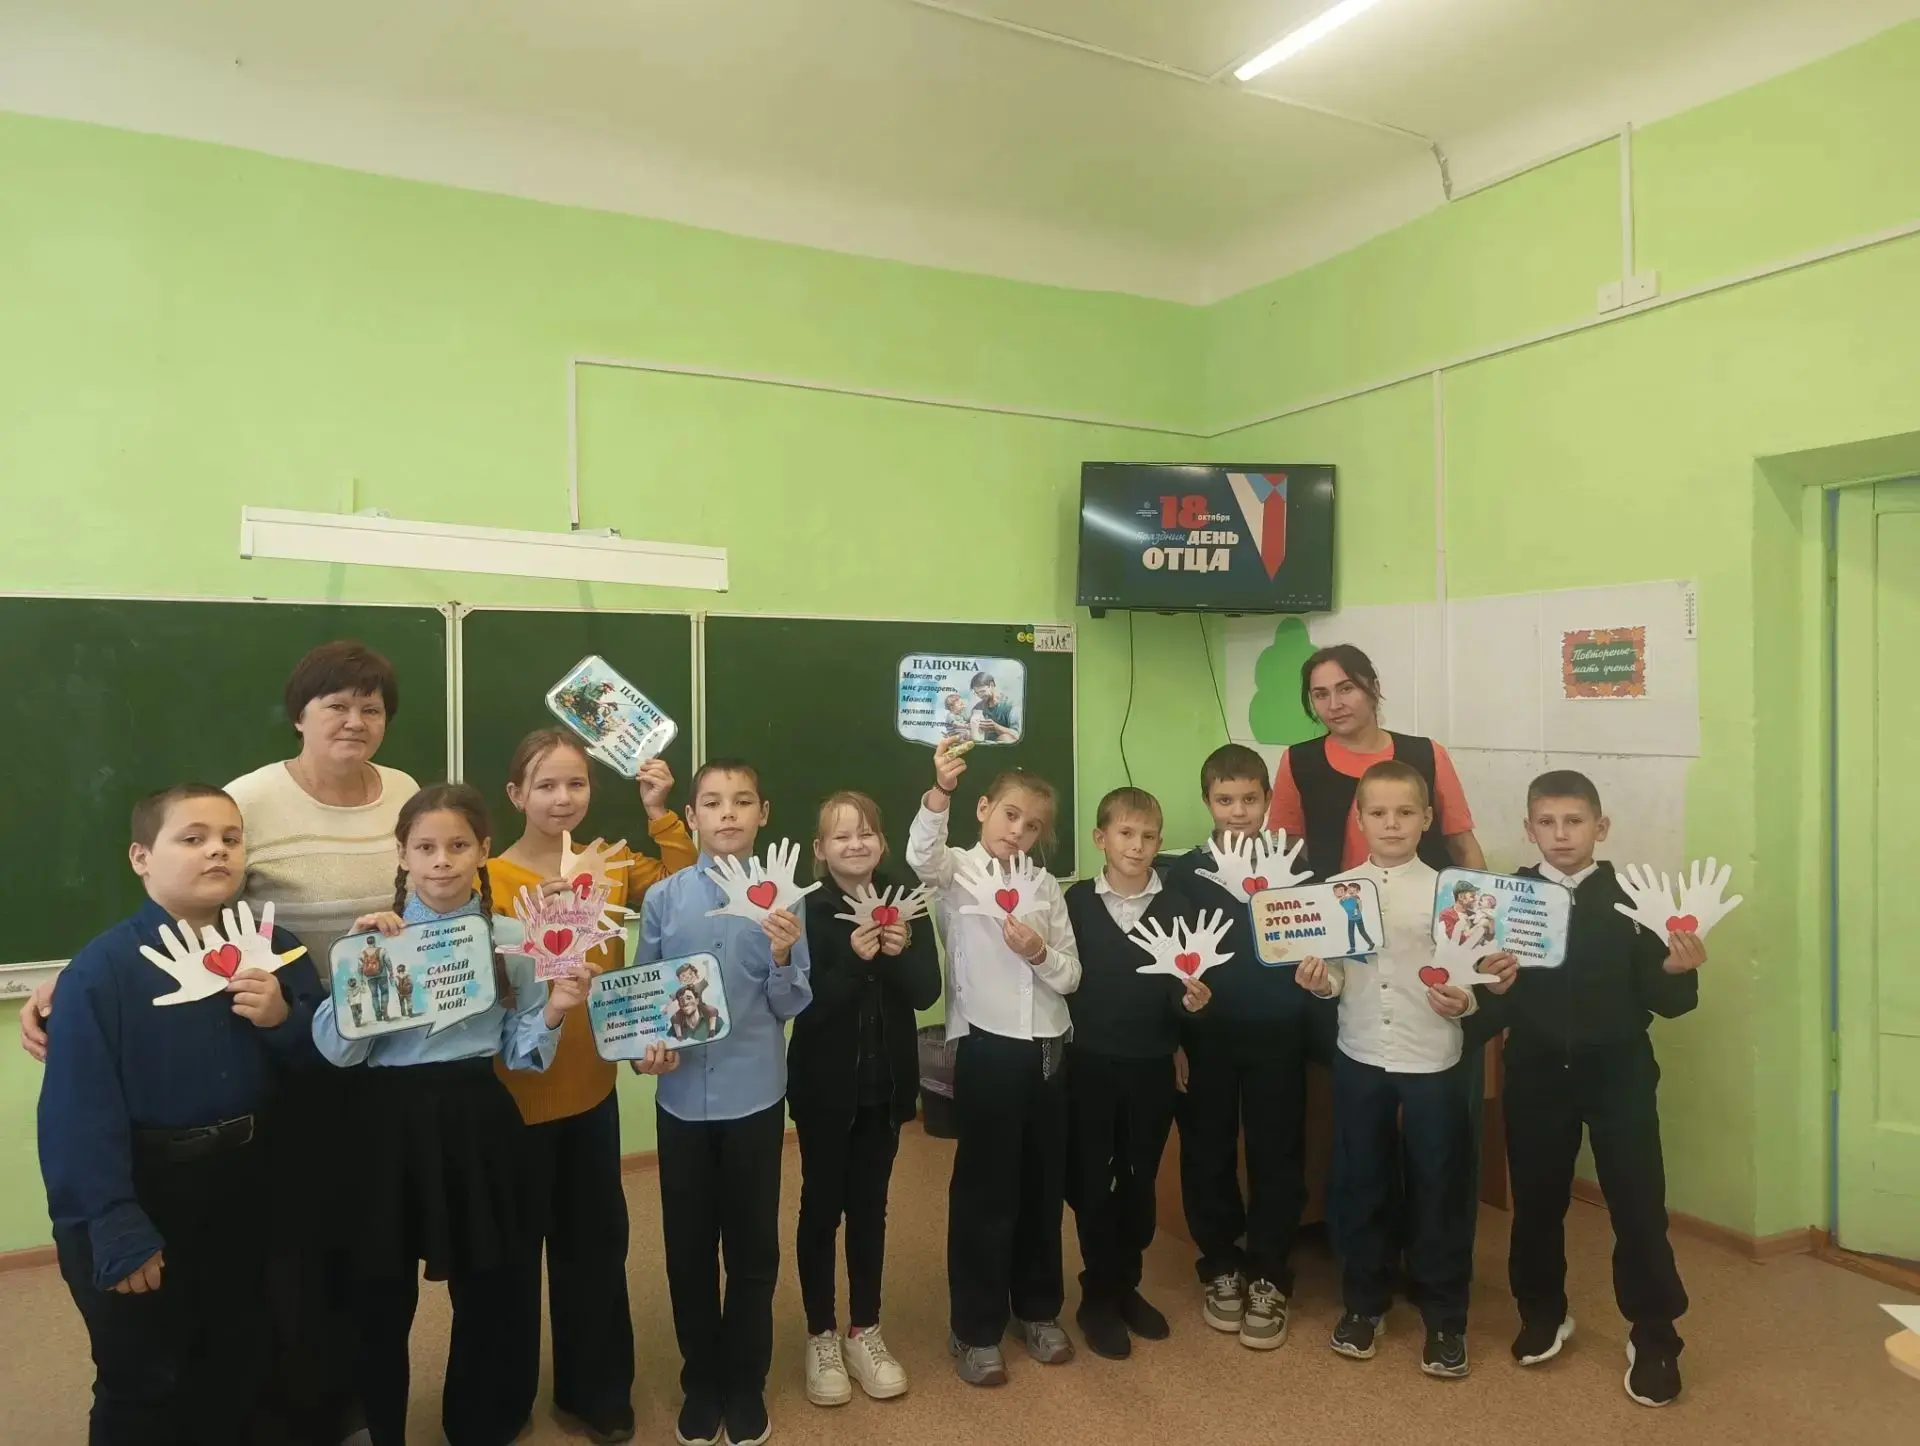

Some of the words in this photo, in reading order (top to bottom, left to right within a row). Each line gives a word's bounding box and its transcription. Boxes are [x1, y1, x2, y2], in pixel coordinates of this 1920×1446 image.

[1160, 495, 1208, 529] 18
[1197, 513, 1231, 522] октября
[1187, 530, 1239, 545] ДЕНЬ
[1142, 547, 1230, 573] ОТЦА
[913, 659, 979, 671] ПАПОЧКА
[902, 672, 933, 680] Может
[620, 686, 664, 726] ПАПОЧК
[902, 695, 932, 703] Может
[1495, 879, 1535, 894] ПАПА
[1266, 900, 1302, 912] ПАПА
[1512, 895, 1546, 906] Может
[1508, 906, 1548, 917] рисовать
[1265, 916, 1291, 927] ЭТО
[1294, 912, 1322, 923] ВАМ
[421, 929, 440, 940] Для
[442, 925, 466, 935] меня
[1264, 931, 1281, 941] НЕ
[1284, 926, 1327, 939] МАМА!
[1511, 928, 1542, 937] может
[416, 941, 447, 952] всегда
[449, 936, 474, 948] герой
[1505, 937, 1545, 949] собирать
[427, 959, 469, 975] САМЫЙ
[425, 970, 475, 989] ЛУЧШИЙ
[600, 969, 662, 992] ПАПУЛЯ
[435, 986, 467, 1000] ПАПА
[593, 997, 626, 1009] Может
[627, 989, 665, 1001] поиграть
[437, 999, 467, 1012] МОЙ!
[606, 1019, 639, 1031] Может
[640, 1013, 662, 1023] даже
